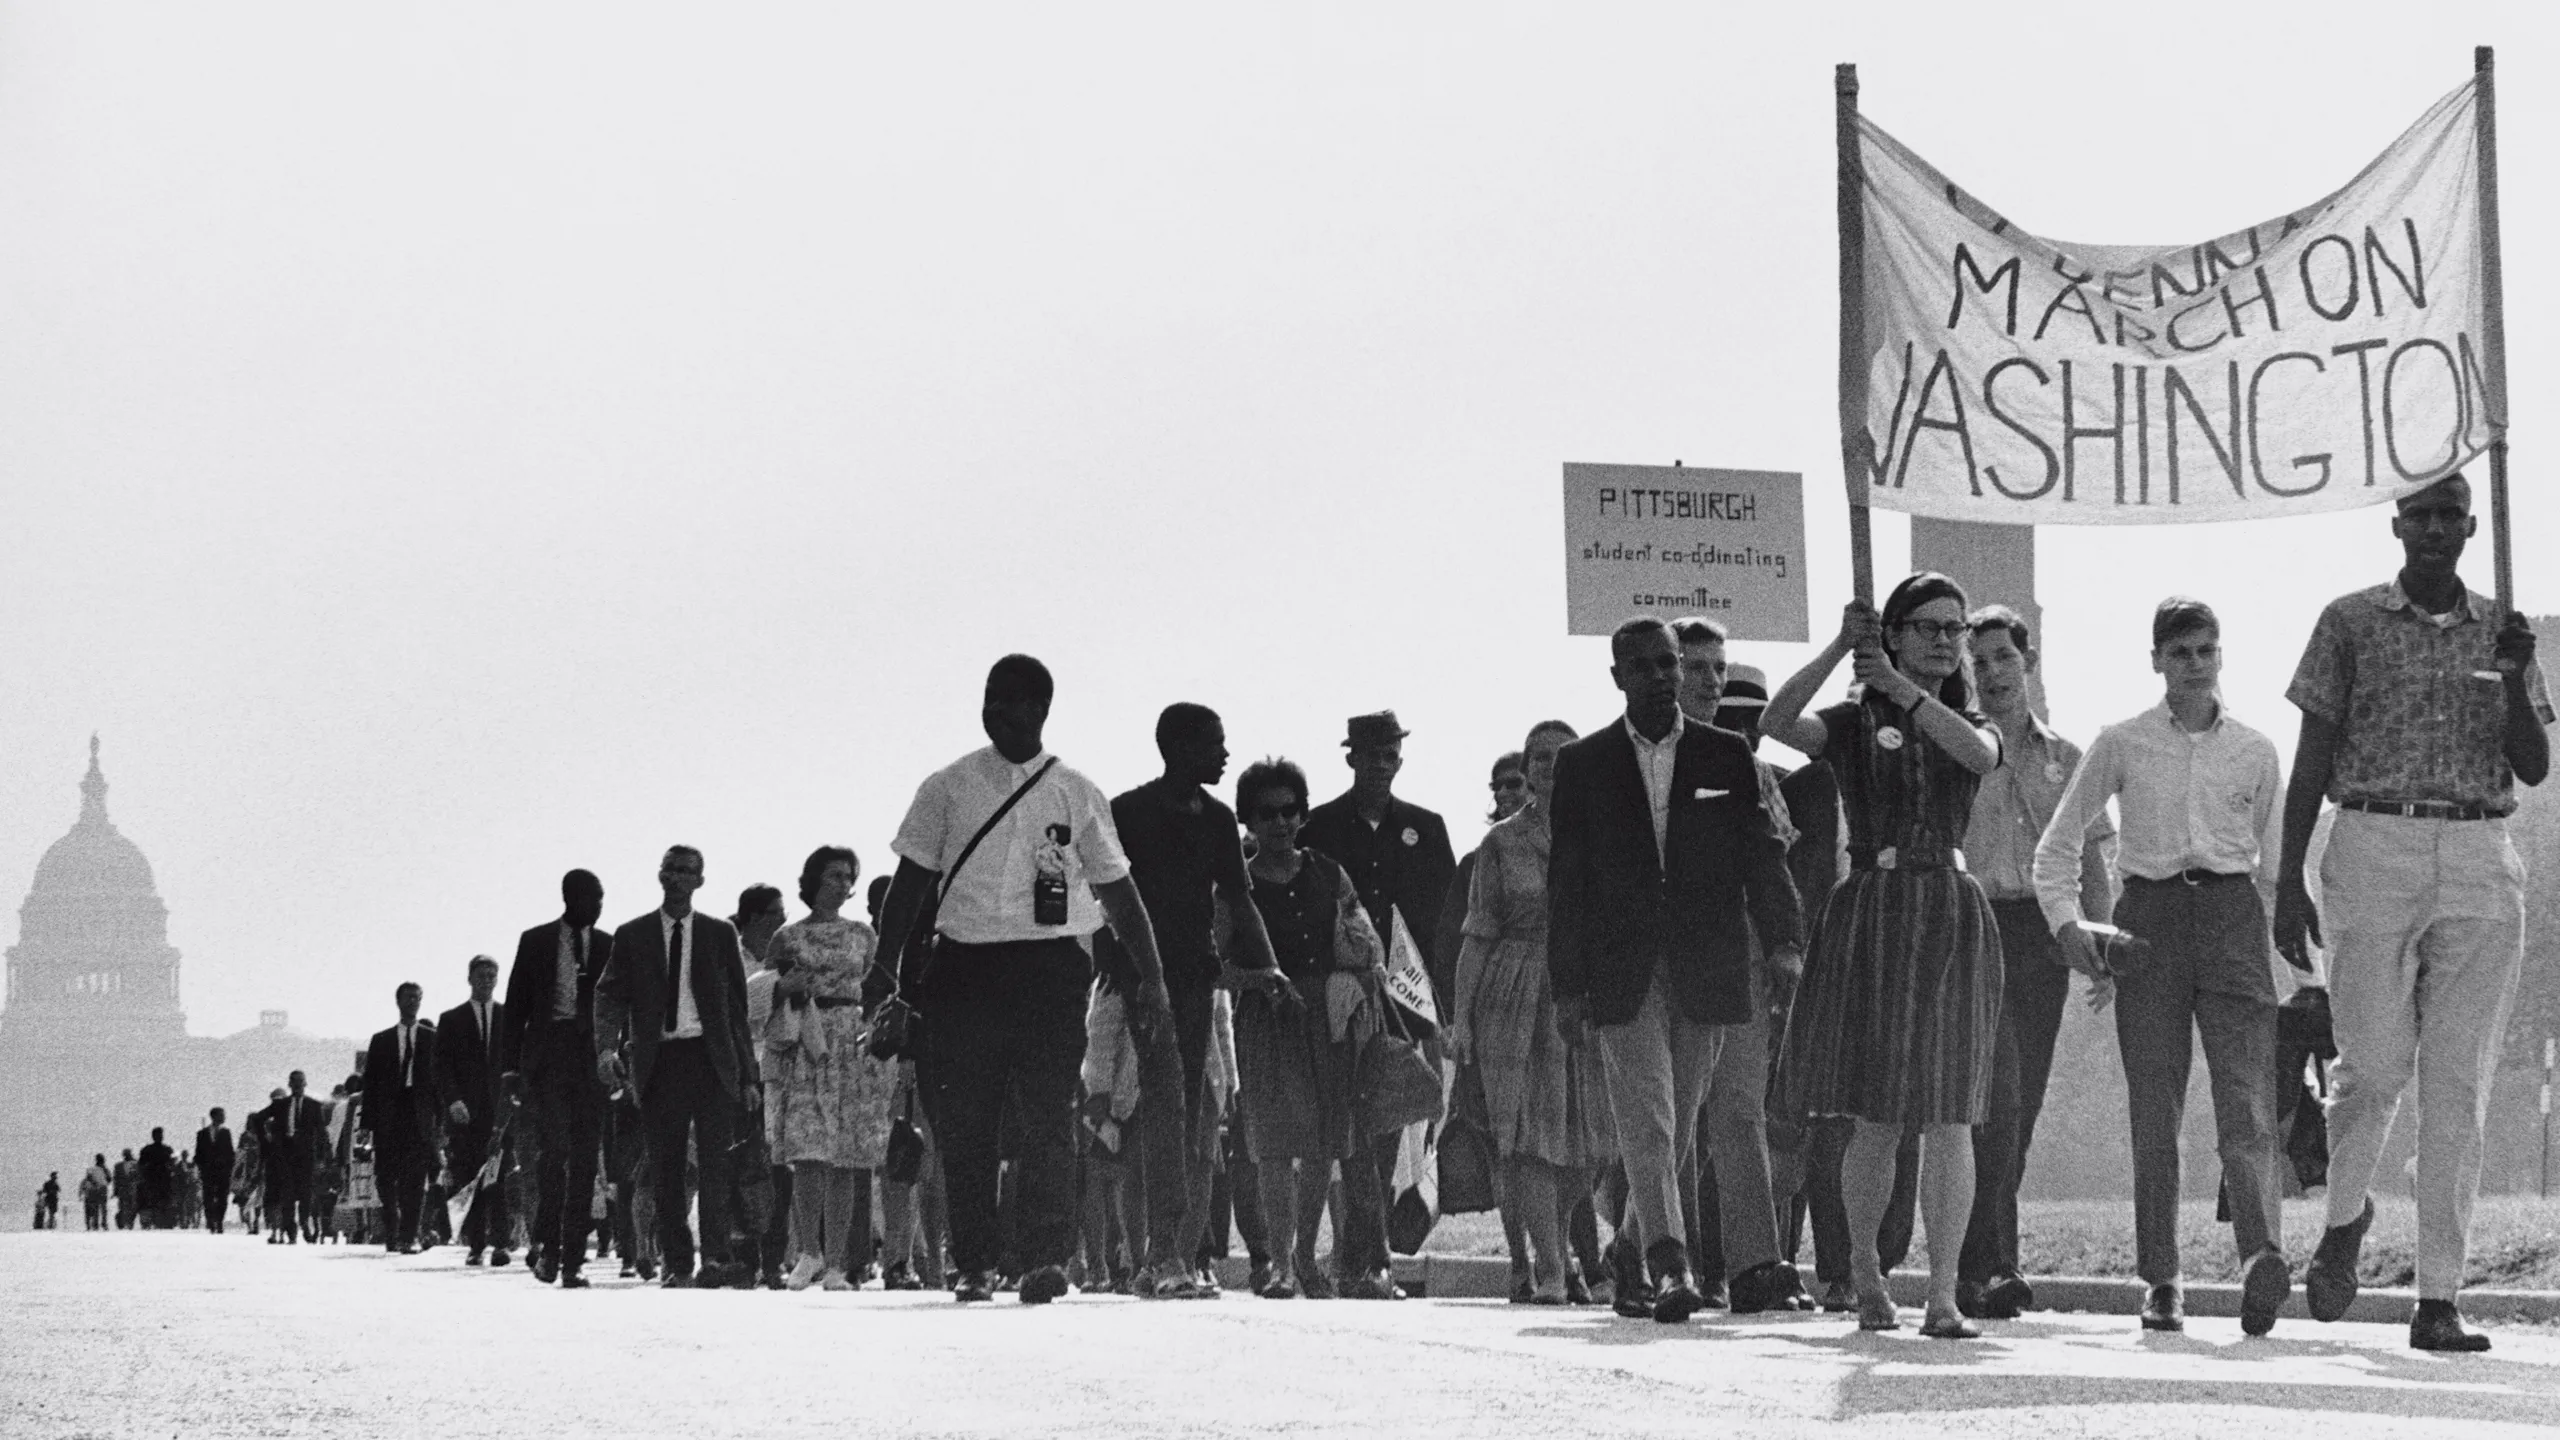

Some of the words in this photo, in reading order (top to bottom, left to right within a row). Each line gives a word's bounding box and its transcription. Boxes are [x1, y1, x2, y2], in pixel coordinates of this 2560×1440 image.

[1947, 242, 2280, 358] MARCH
[2299, 218, 2428, 320] ON
[1600, 488, 1756, 521] PITTSBURGH
[1583, 541, 1652, 561] student
[1632, 586, 1733, 609] committee
[1402, 965, 1423, 986] all
